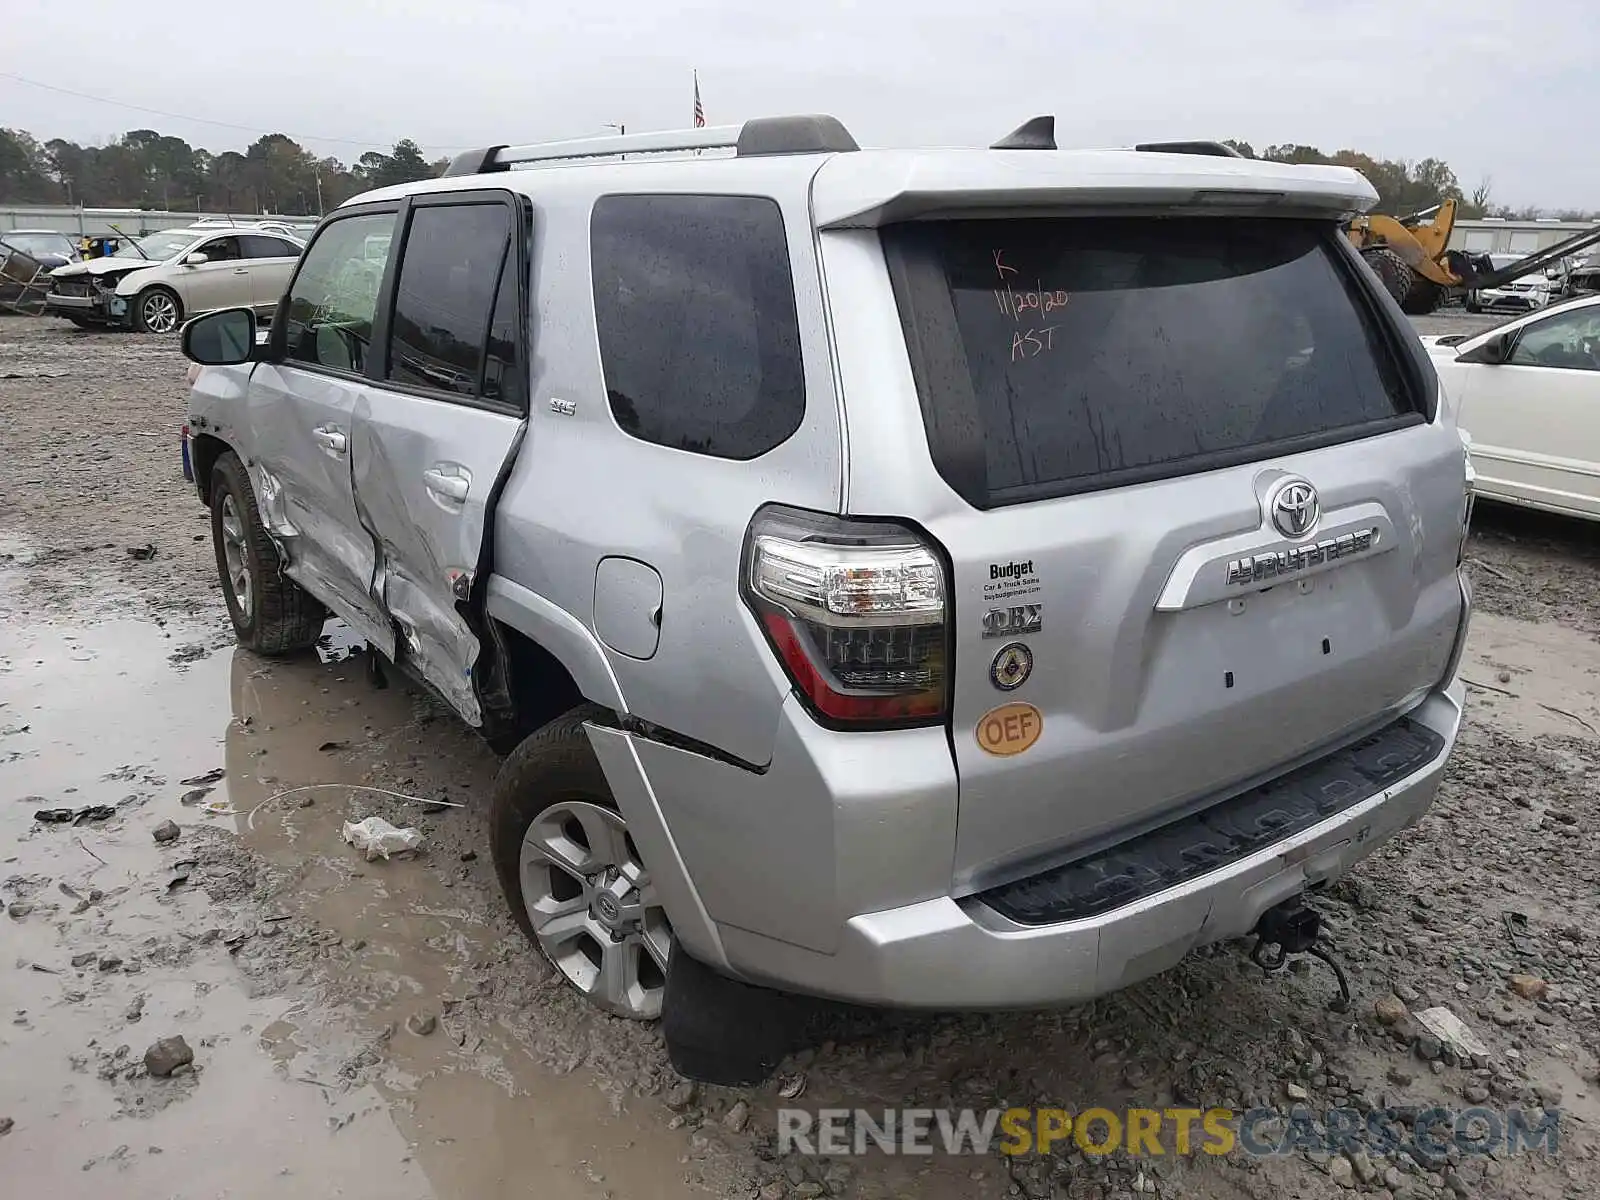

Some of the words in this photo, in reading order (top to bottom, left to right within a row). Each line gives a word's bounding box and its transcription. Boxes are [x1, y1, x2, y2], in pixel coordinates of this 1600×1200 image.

[992, 248, 1019, 279] K
[1011, 325, 1062, 362] AST
[989, 560, 1034, 580] Budget
[1003, 579, 1020, 588] Truck
[985, 711, 1033, 745] OEF
